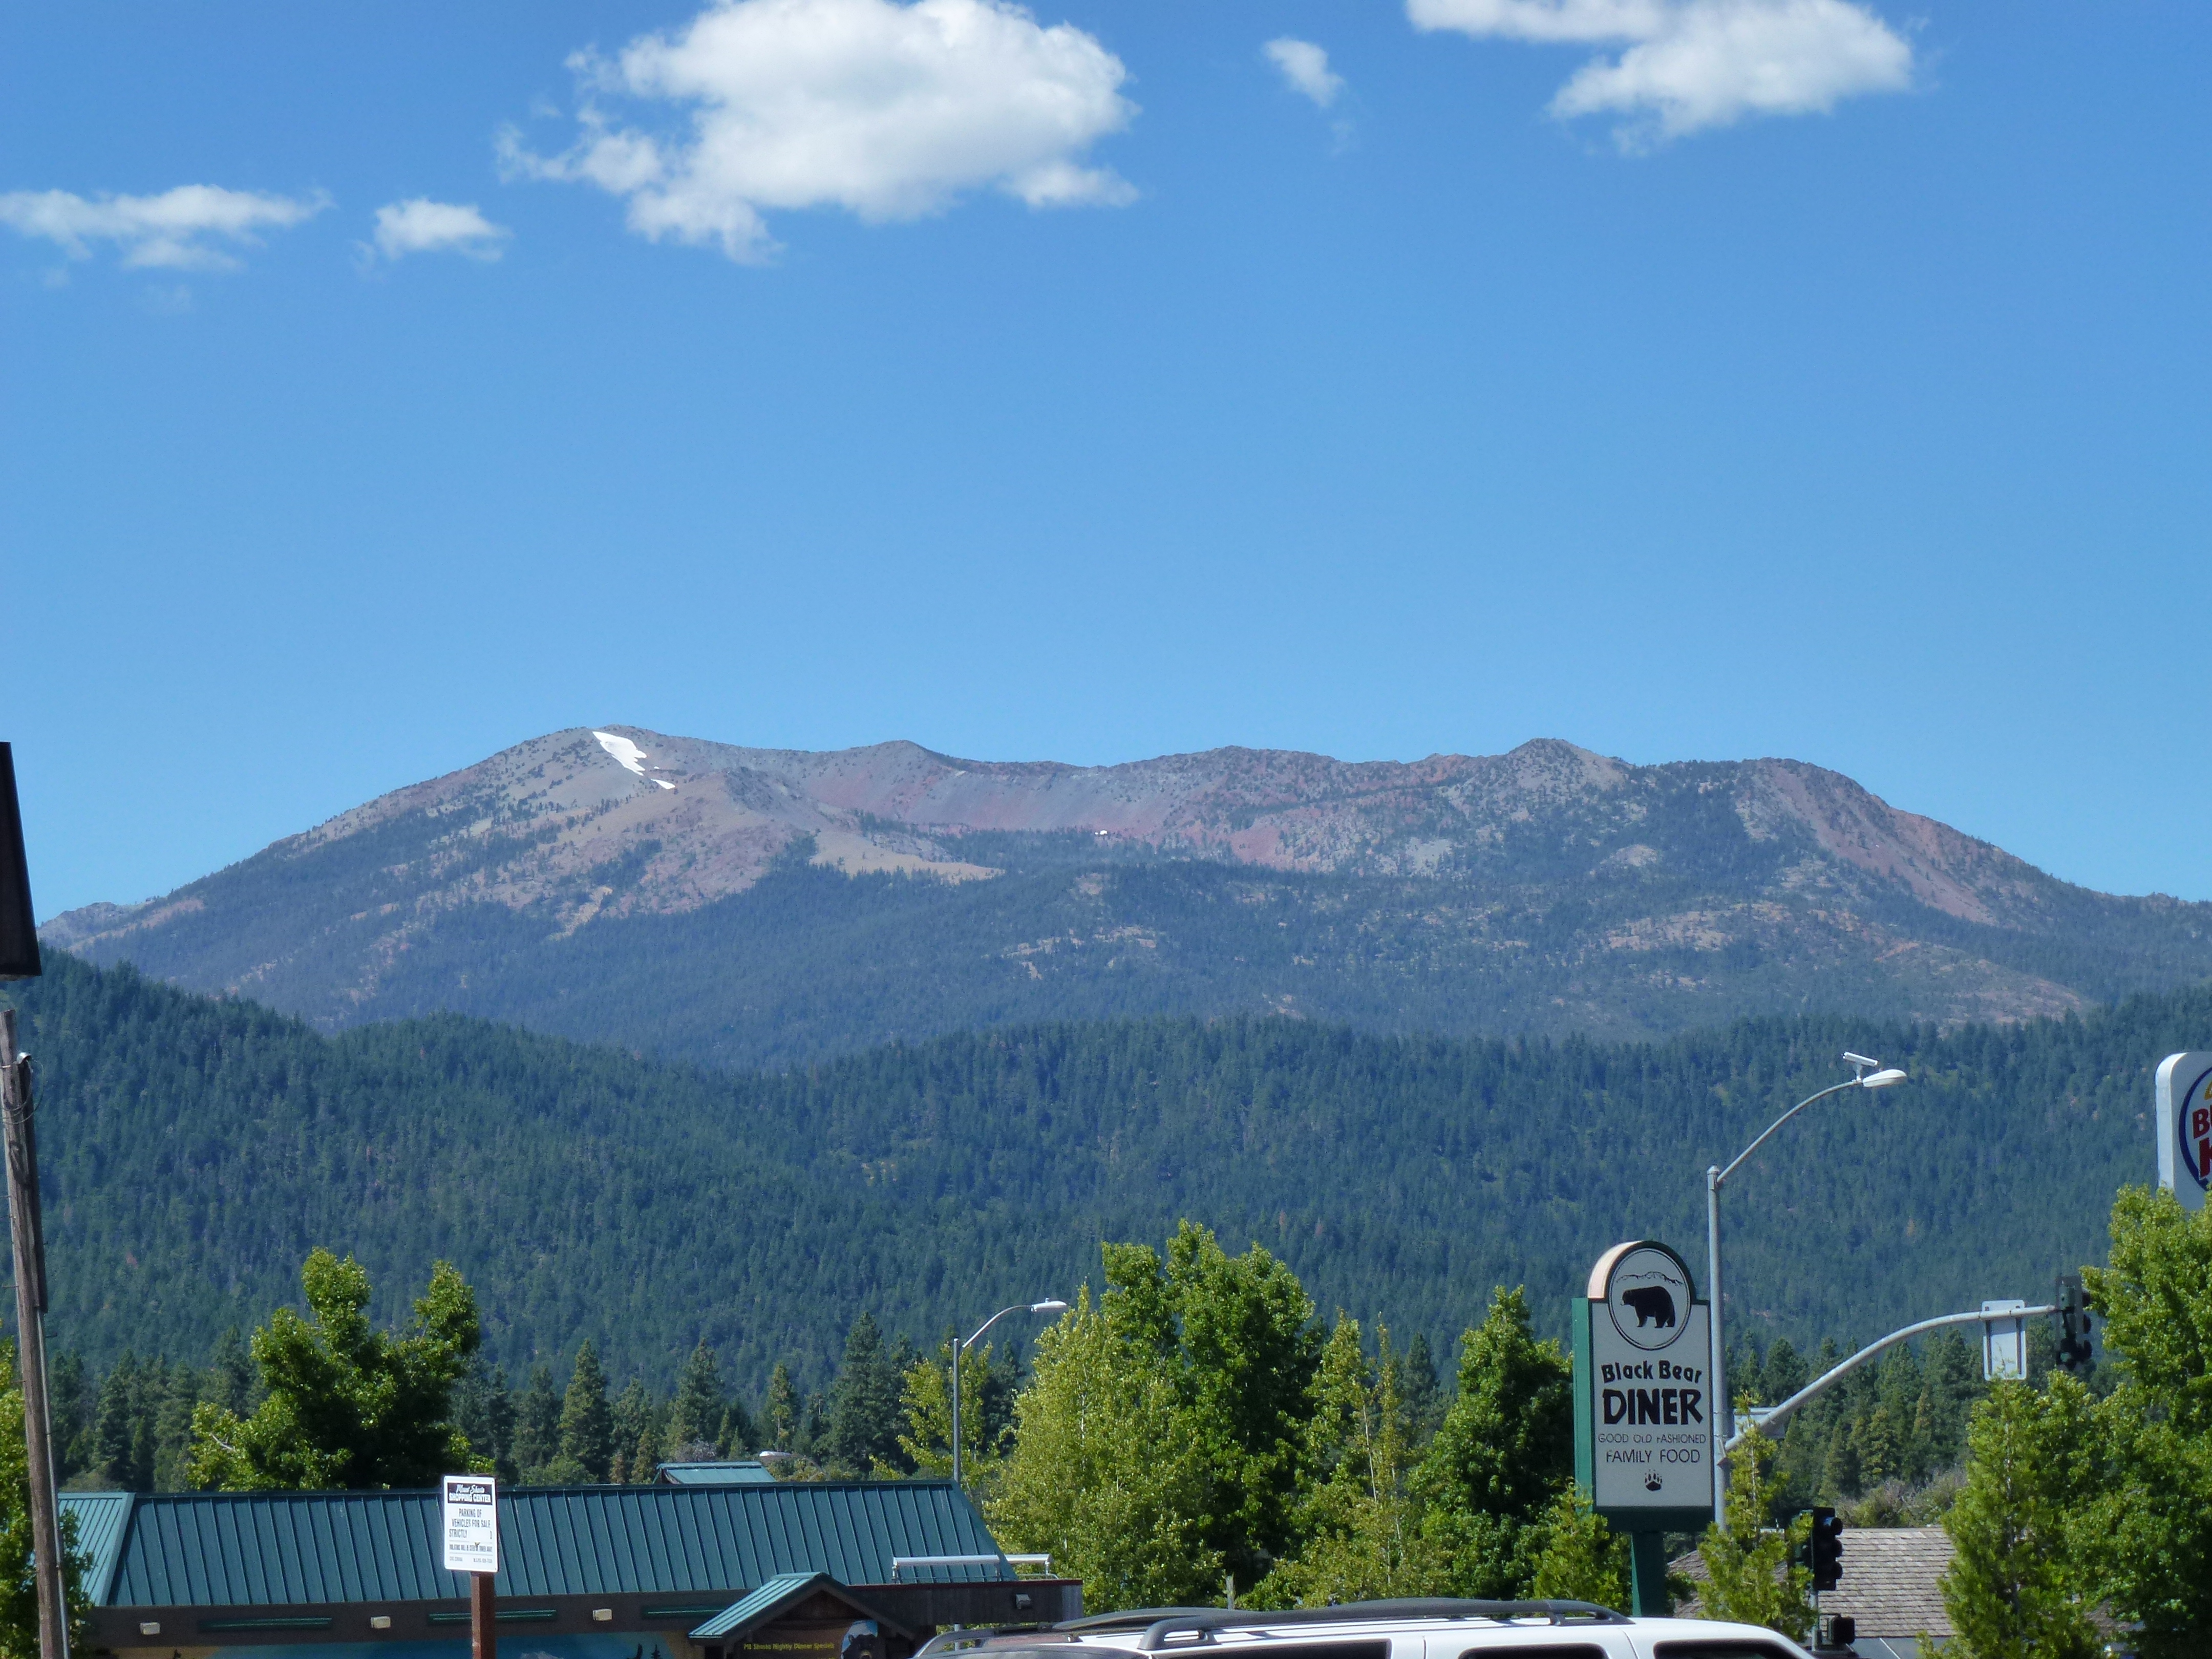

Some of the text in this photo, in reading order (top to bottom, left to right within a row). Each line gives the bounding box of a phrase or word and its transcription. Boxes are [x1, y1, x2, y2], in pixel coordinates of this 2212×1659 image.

[1601, 1360, 1703, 1384] Black Bear
[1602, 1388, 1704, 1425] DINER
[1598, 1433, 1707, 1444] GOOD OLD FASHIONED
[1606, 1449, 1700, 1463] FAMILY FOOD
[449, 1493, 491, 1502] SHOPPING CENTER
[459, 1508, 482, 1518] PARKING OF
[452, 1518, 491, 1528] VEHICLES FOR SALE
[449, 1529, 467, 1538] STRICTLY
